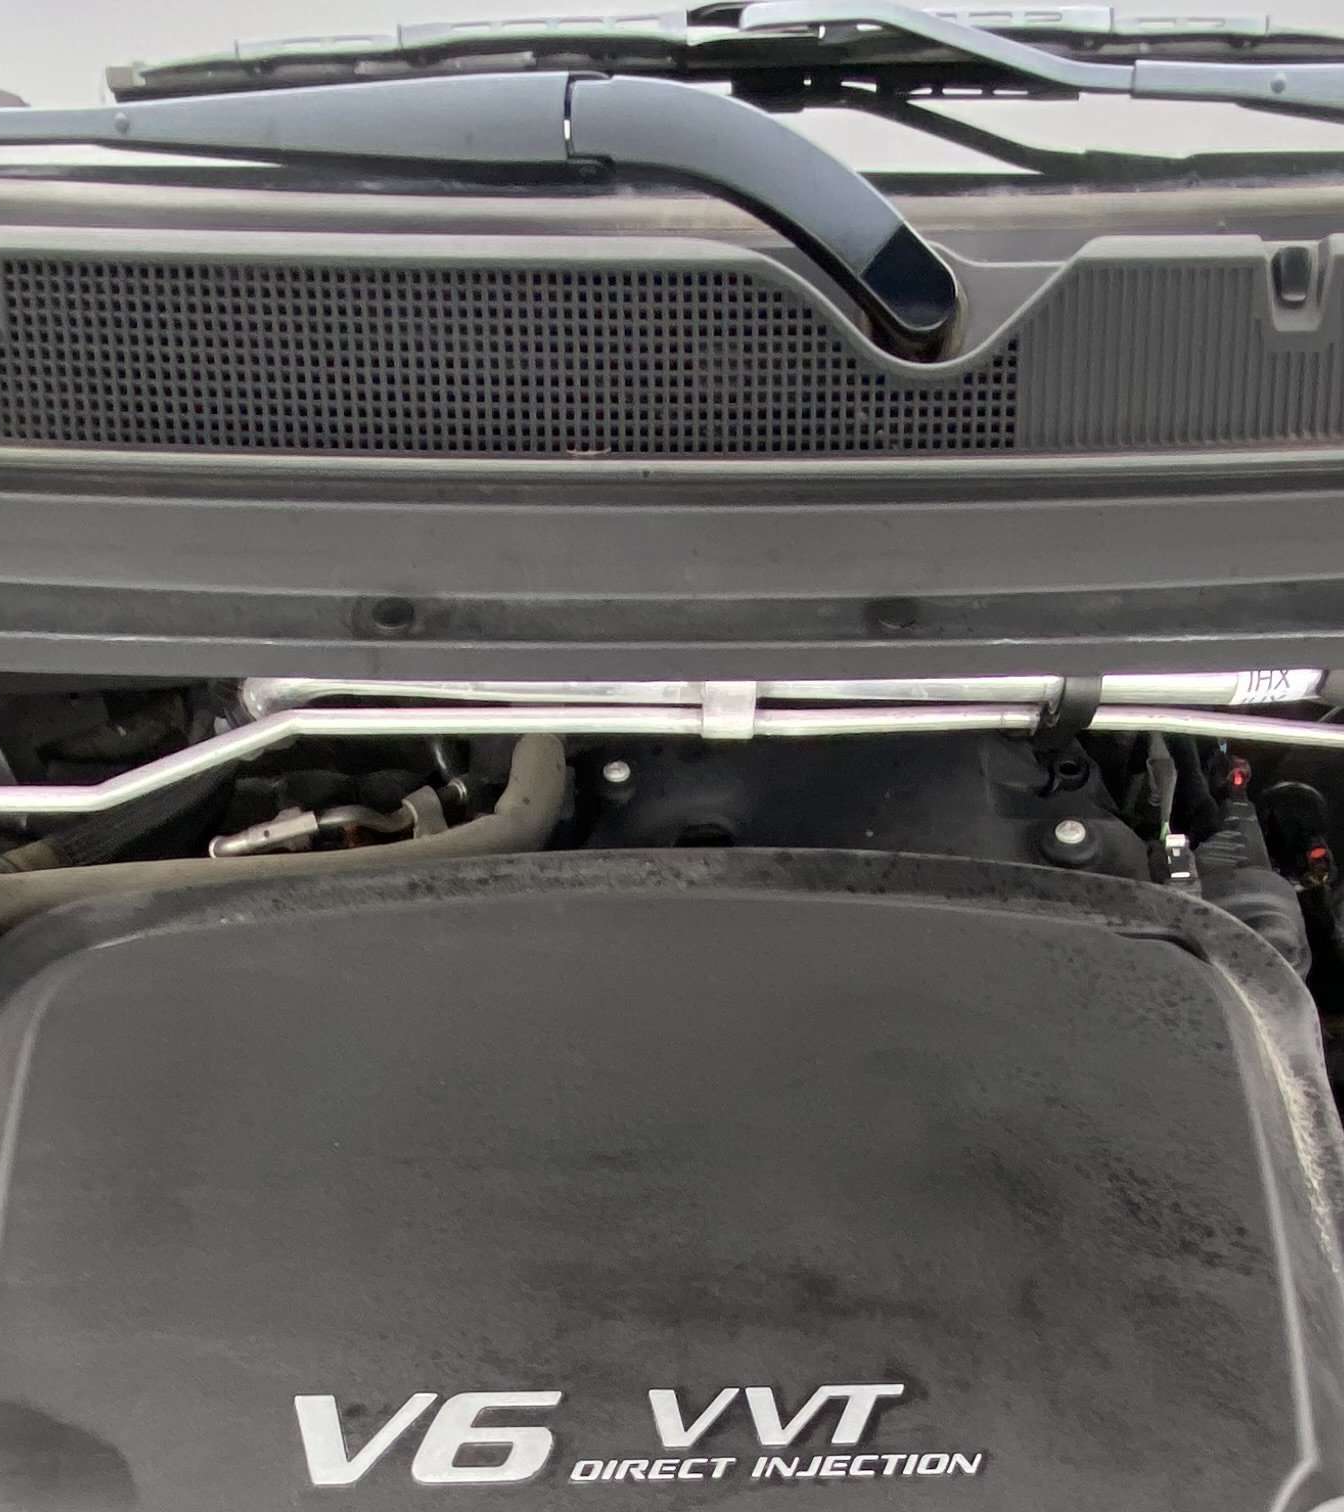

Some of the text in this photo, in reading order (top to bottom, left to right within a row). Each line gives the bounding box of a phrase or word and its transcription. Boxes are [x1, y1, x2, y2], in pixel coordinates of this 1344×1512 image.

[294, 1391, 563, 1485] V6
[649, 1383, 905, 1448] VVT
[569, 1453, 983, 1482] DIRECT INJECTION
